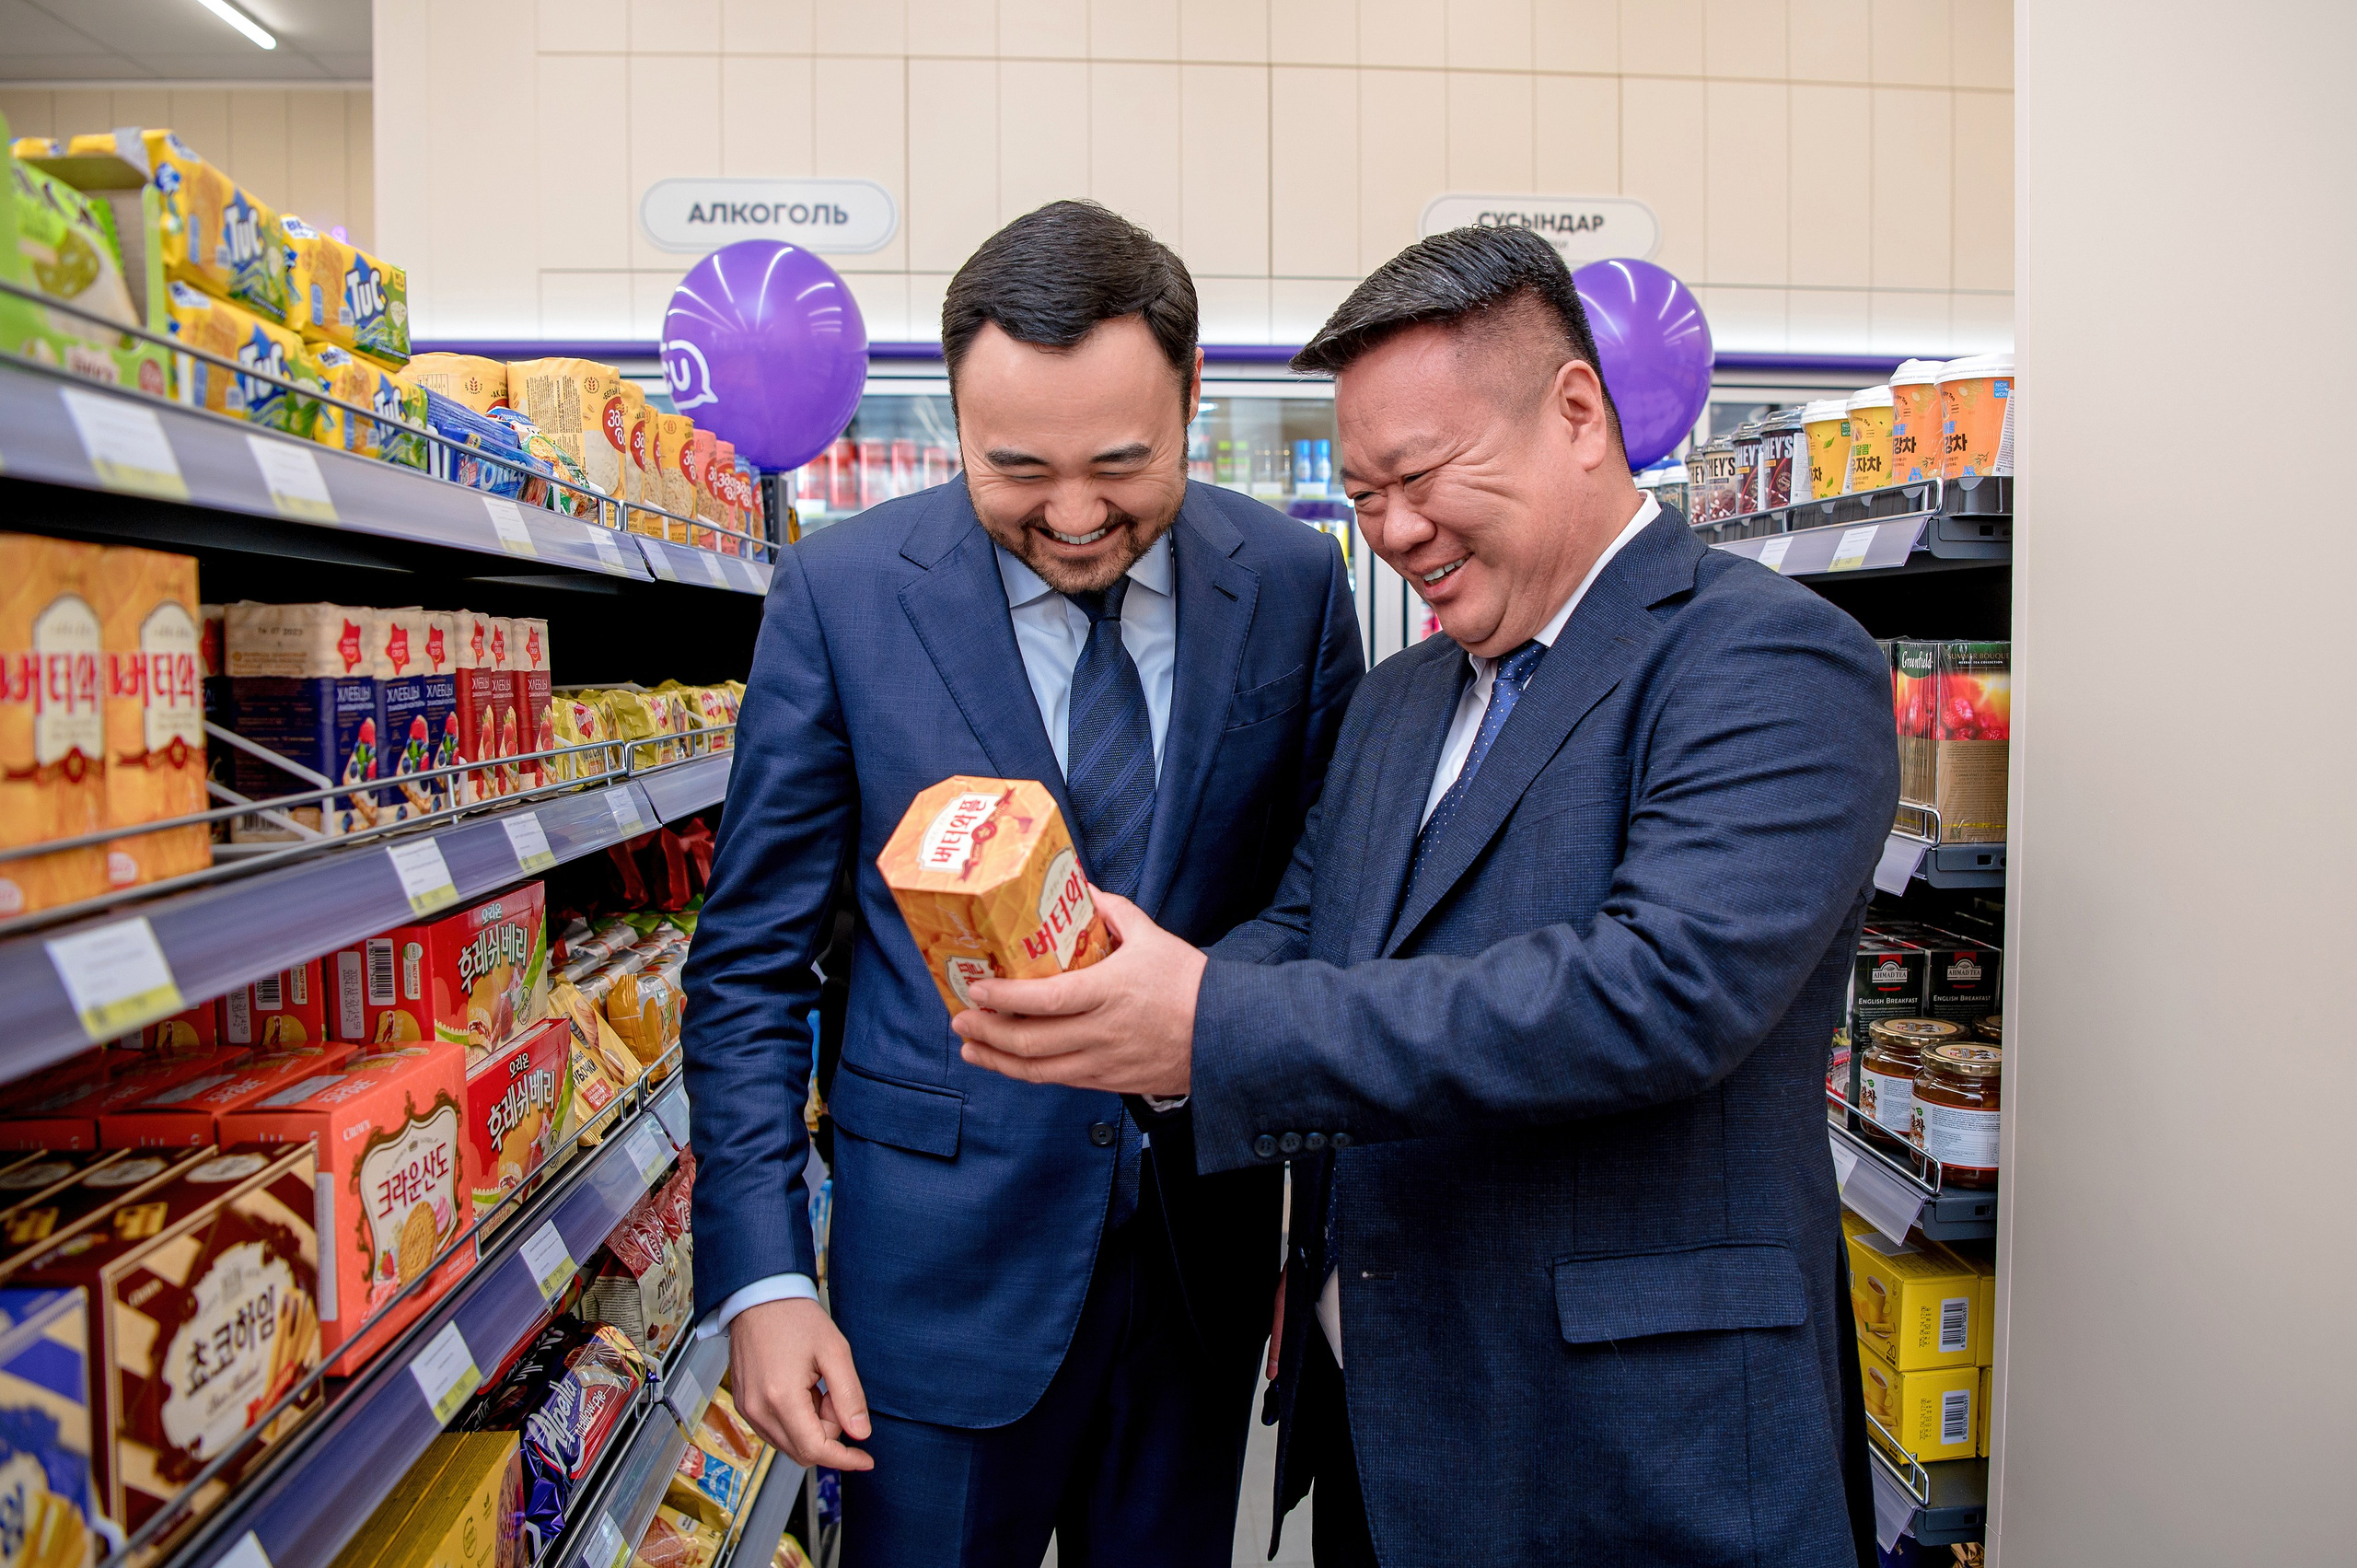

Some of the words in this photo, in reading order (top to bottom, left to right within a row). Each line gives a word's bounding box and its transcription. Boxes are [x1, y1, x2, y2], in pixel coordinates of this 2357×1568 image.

[688, 202, 849, 226] АЛКОГОЛЬ
[1477, 212, 1604, 233] СУСЫНДАР
[931, 800, 987, 863] 버터와플
[482, 902, 503, 925] 오리온
[458, 922, 529, 997] 후레쉬베리
[1948, 967, 1970, 976] AHMAD
[1970, 967, 1980, 976] TEA
[1873, 970, 1895, 979] AHMAD
[1896, 970, 1907, 979] TEA
[508, 1051, 529, 1079] 오리온
[487, 1069, 556, 1153] 후레쉬베리
[343, 1119, 371, 1142] CROWN
[377, 1142, 449, 1220] 크라운산도
[657, 1266, 678, 1300] mini
[186, 1283, 275, 1399] 초코하임
[1887, 1341, 1897, 1361] 20
[528, 1377, 578, 1474] Alpella
